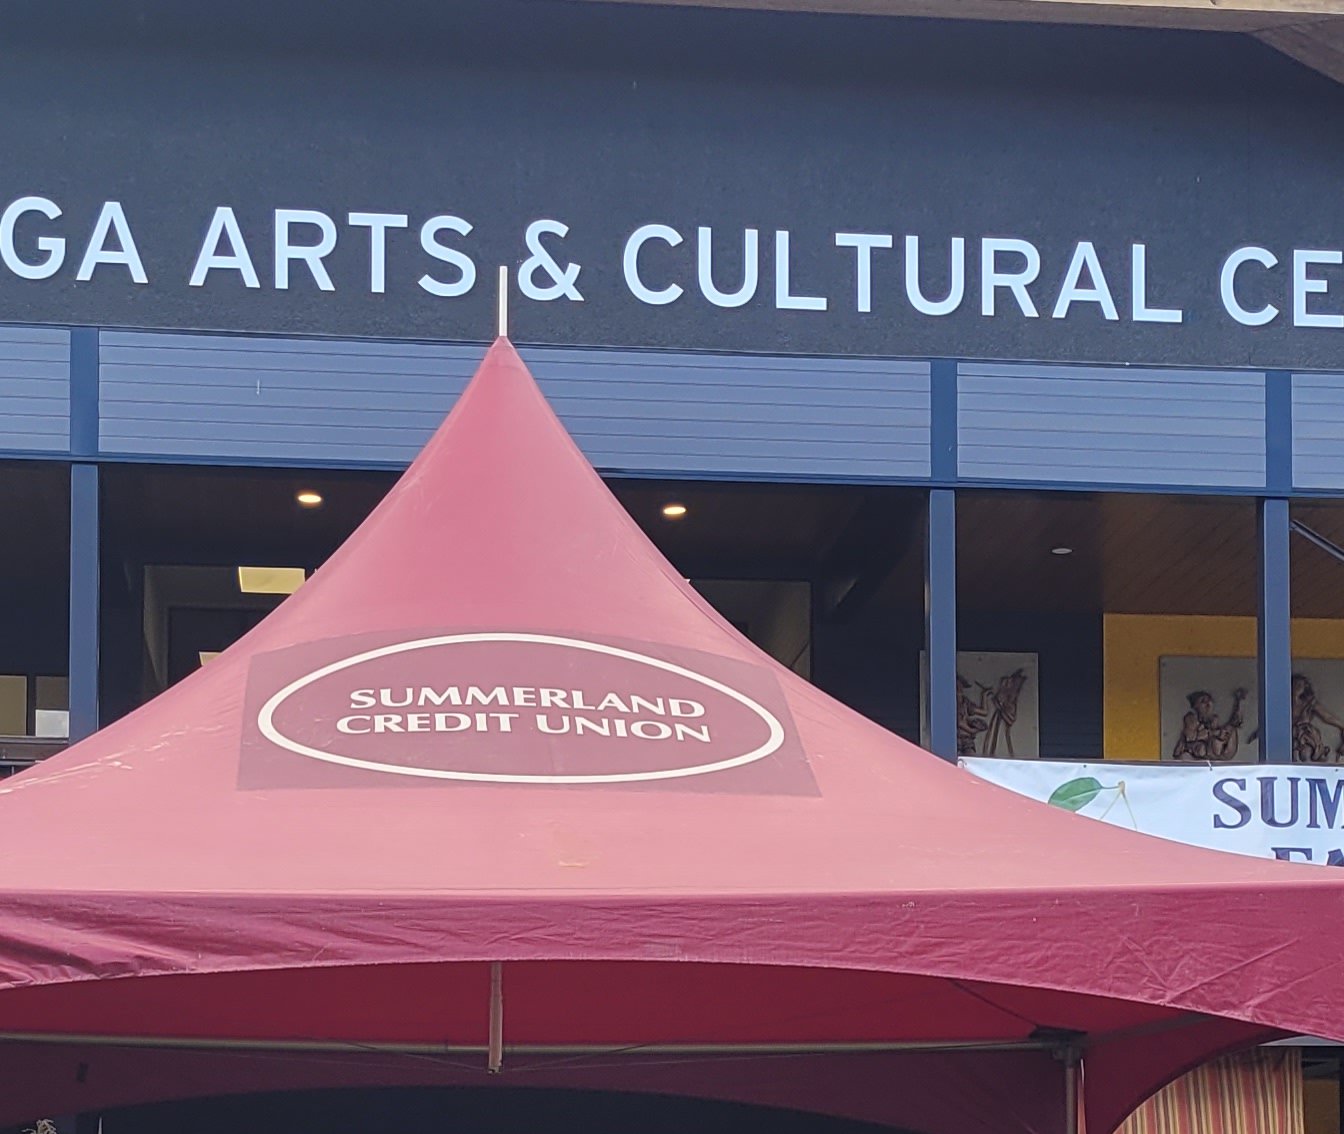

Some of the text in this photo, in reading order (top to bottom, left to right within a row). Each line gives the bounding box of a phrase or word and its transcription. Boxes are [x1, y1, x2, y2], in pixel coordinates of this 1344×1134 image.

[189, 206, 478, 299] ARTS
[516, 218, 584, 302] &
[621, 223, 1183, 326] CULTURAL
[349, 686, 706, 718] SUMMERLAND
[336, 712, 712, 743] CREDIT UNION
